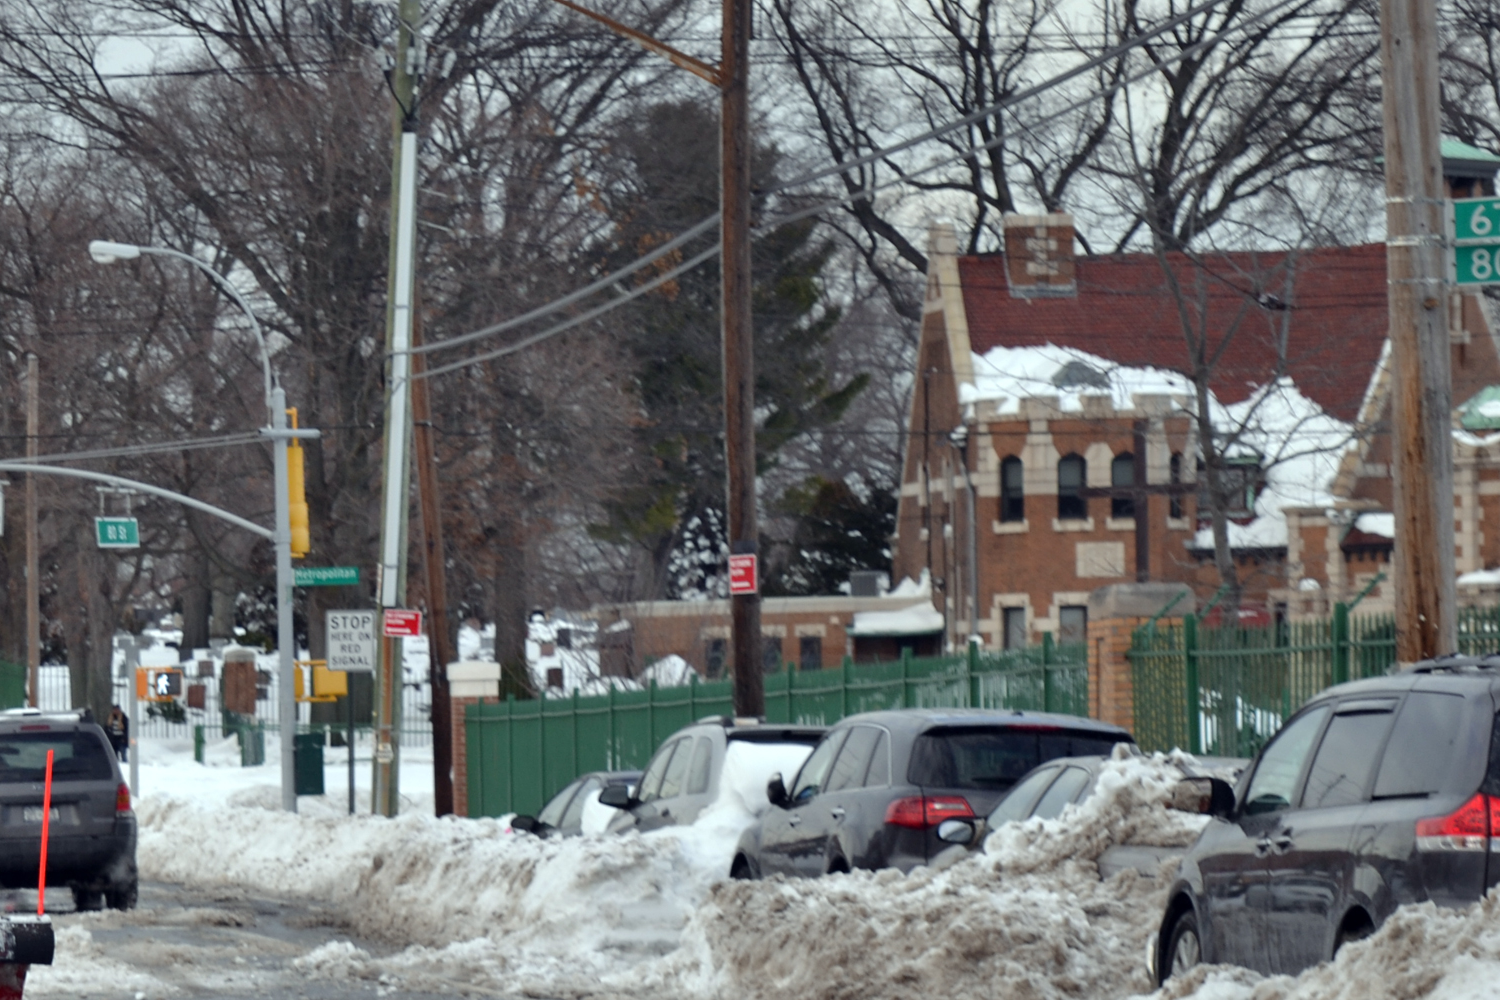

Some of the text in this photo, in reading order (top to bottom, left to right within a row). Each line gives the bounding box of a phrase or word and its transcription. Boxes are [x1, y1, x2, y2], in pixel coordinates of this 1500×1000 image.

[1470, 204, 1500, 235] 6
[1471, 248, 1500, 279] 8
[296, 568, 356, 580] Metropolitan
[331, 615, 371, 629] STOP
[331, 632, 370, 640] HERE ON
[340, 644, 361, 652] RED
[331, 657, 370, 666] SIGNAL
